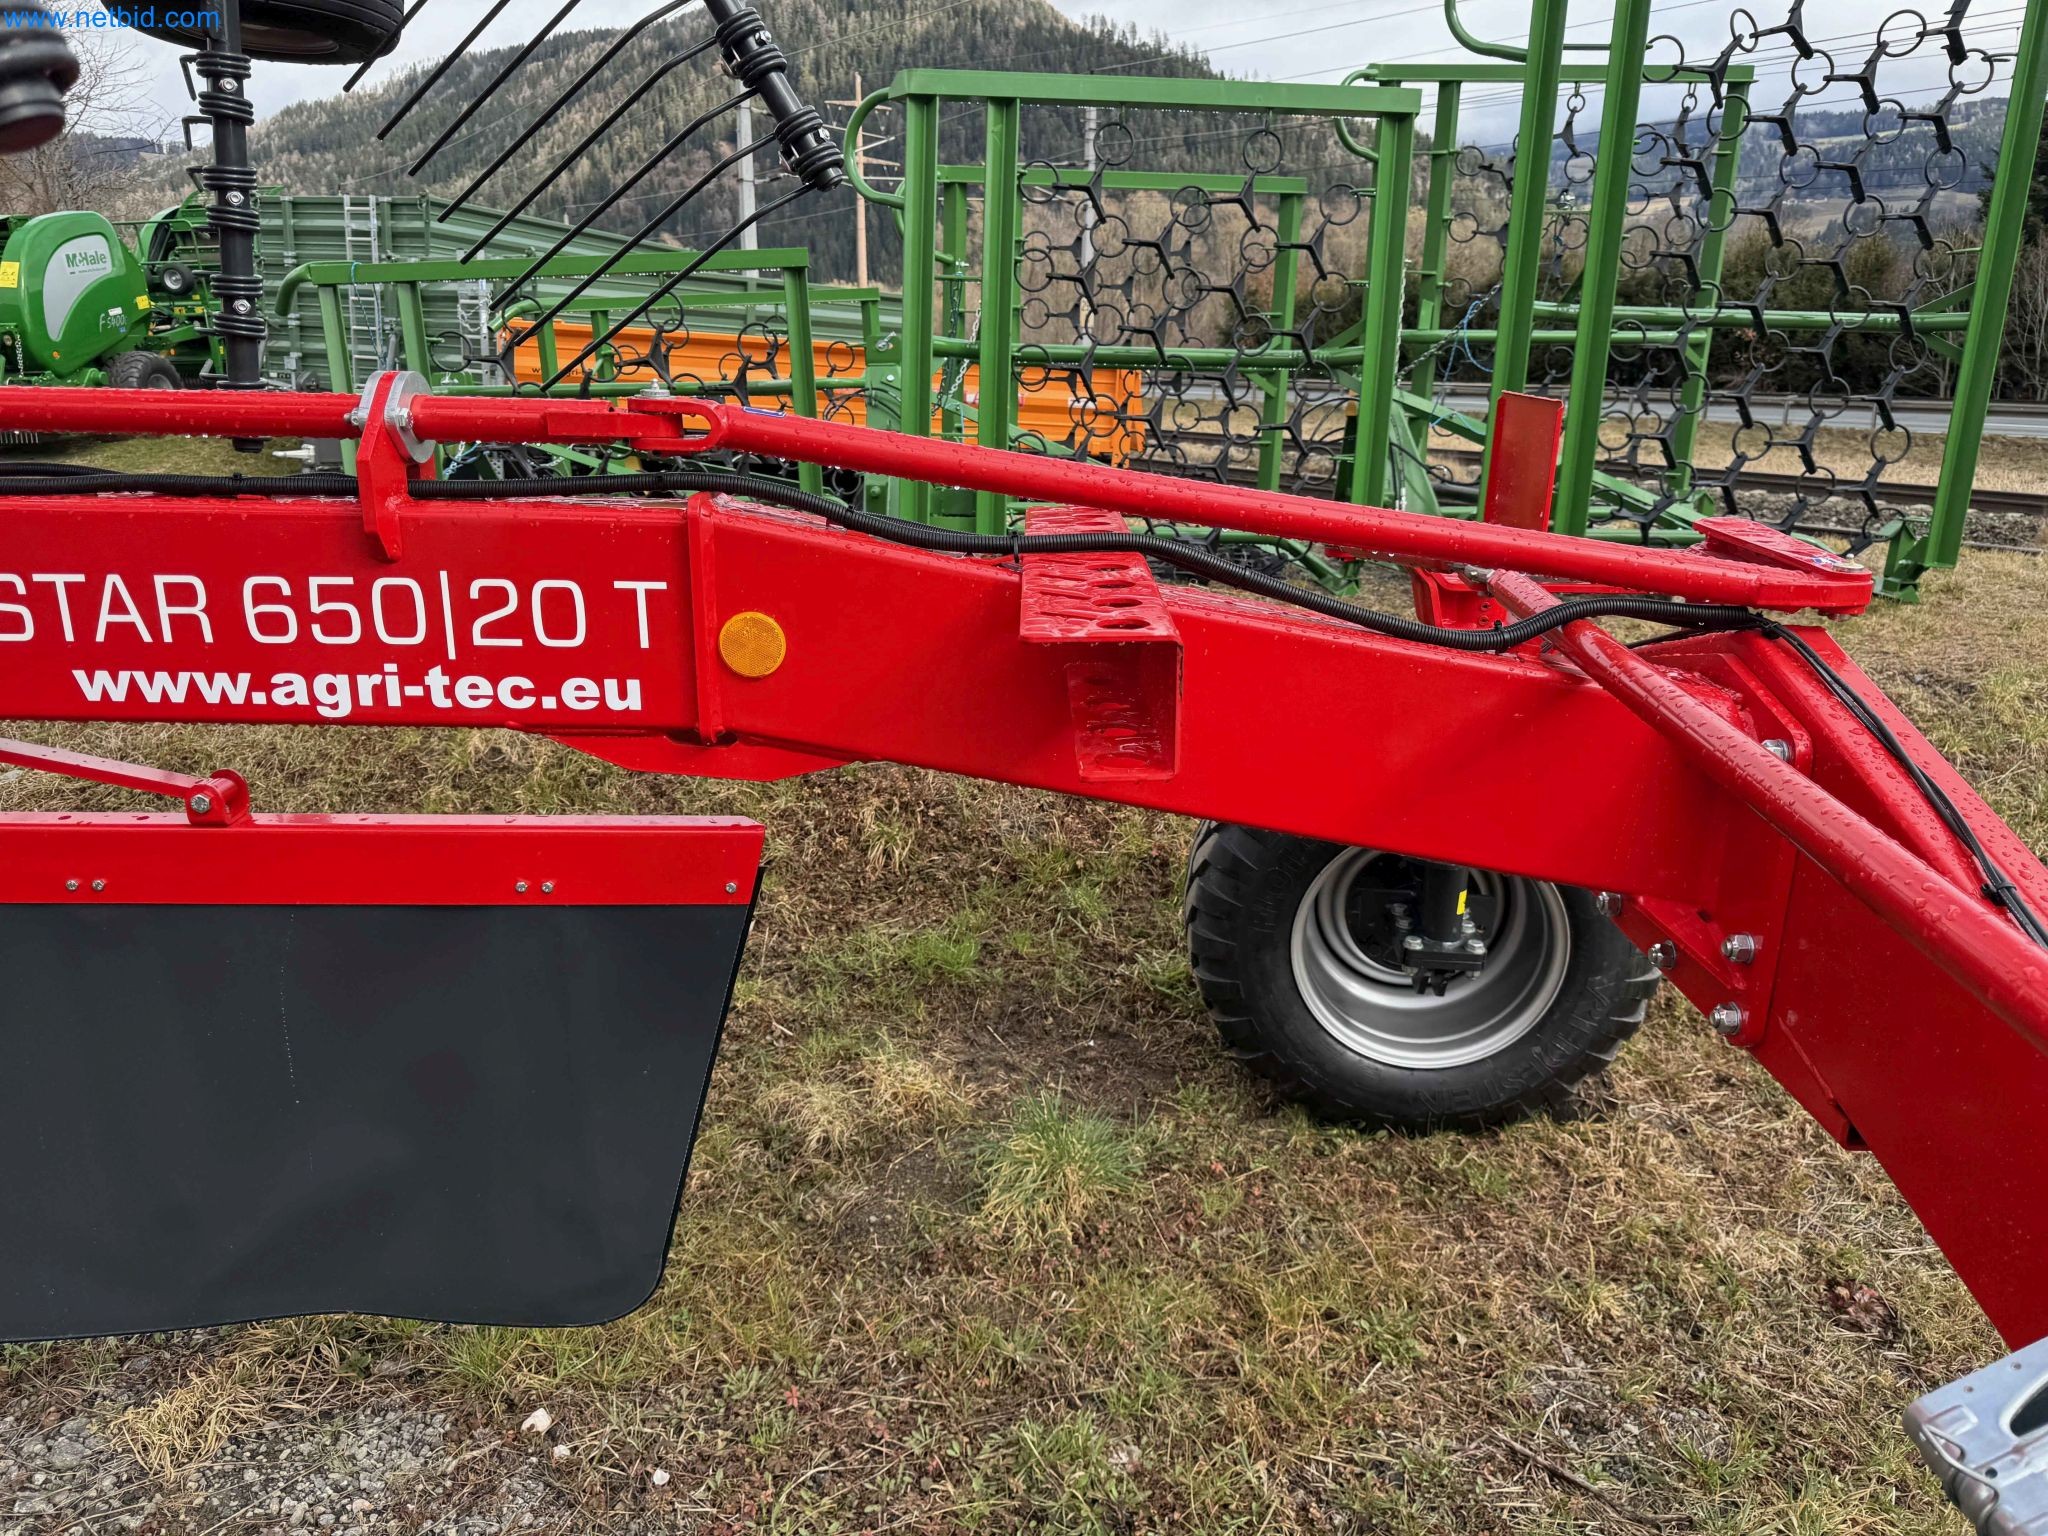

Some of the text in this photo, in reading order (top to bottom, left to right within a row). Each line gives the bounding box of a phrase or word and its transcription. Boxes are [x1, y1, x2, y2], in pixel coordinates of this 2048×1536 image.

[65, 250, 107, 268] McHale
[0, 573, 214, 643] STAR
[613, 580, 668, 649] T
[71, 663, 642, 719] www.agri-tec.eu
